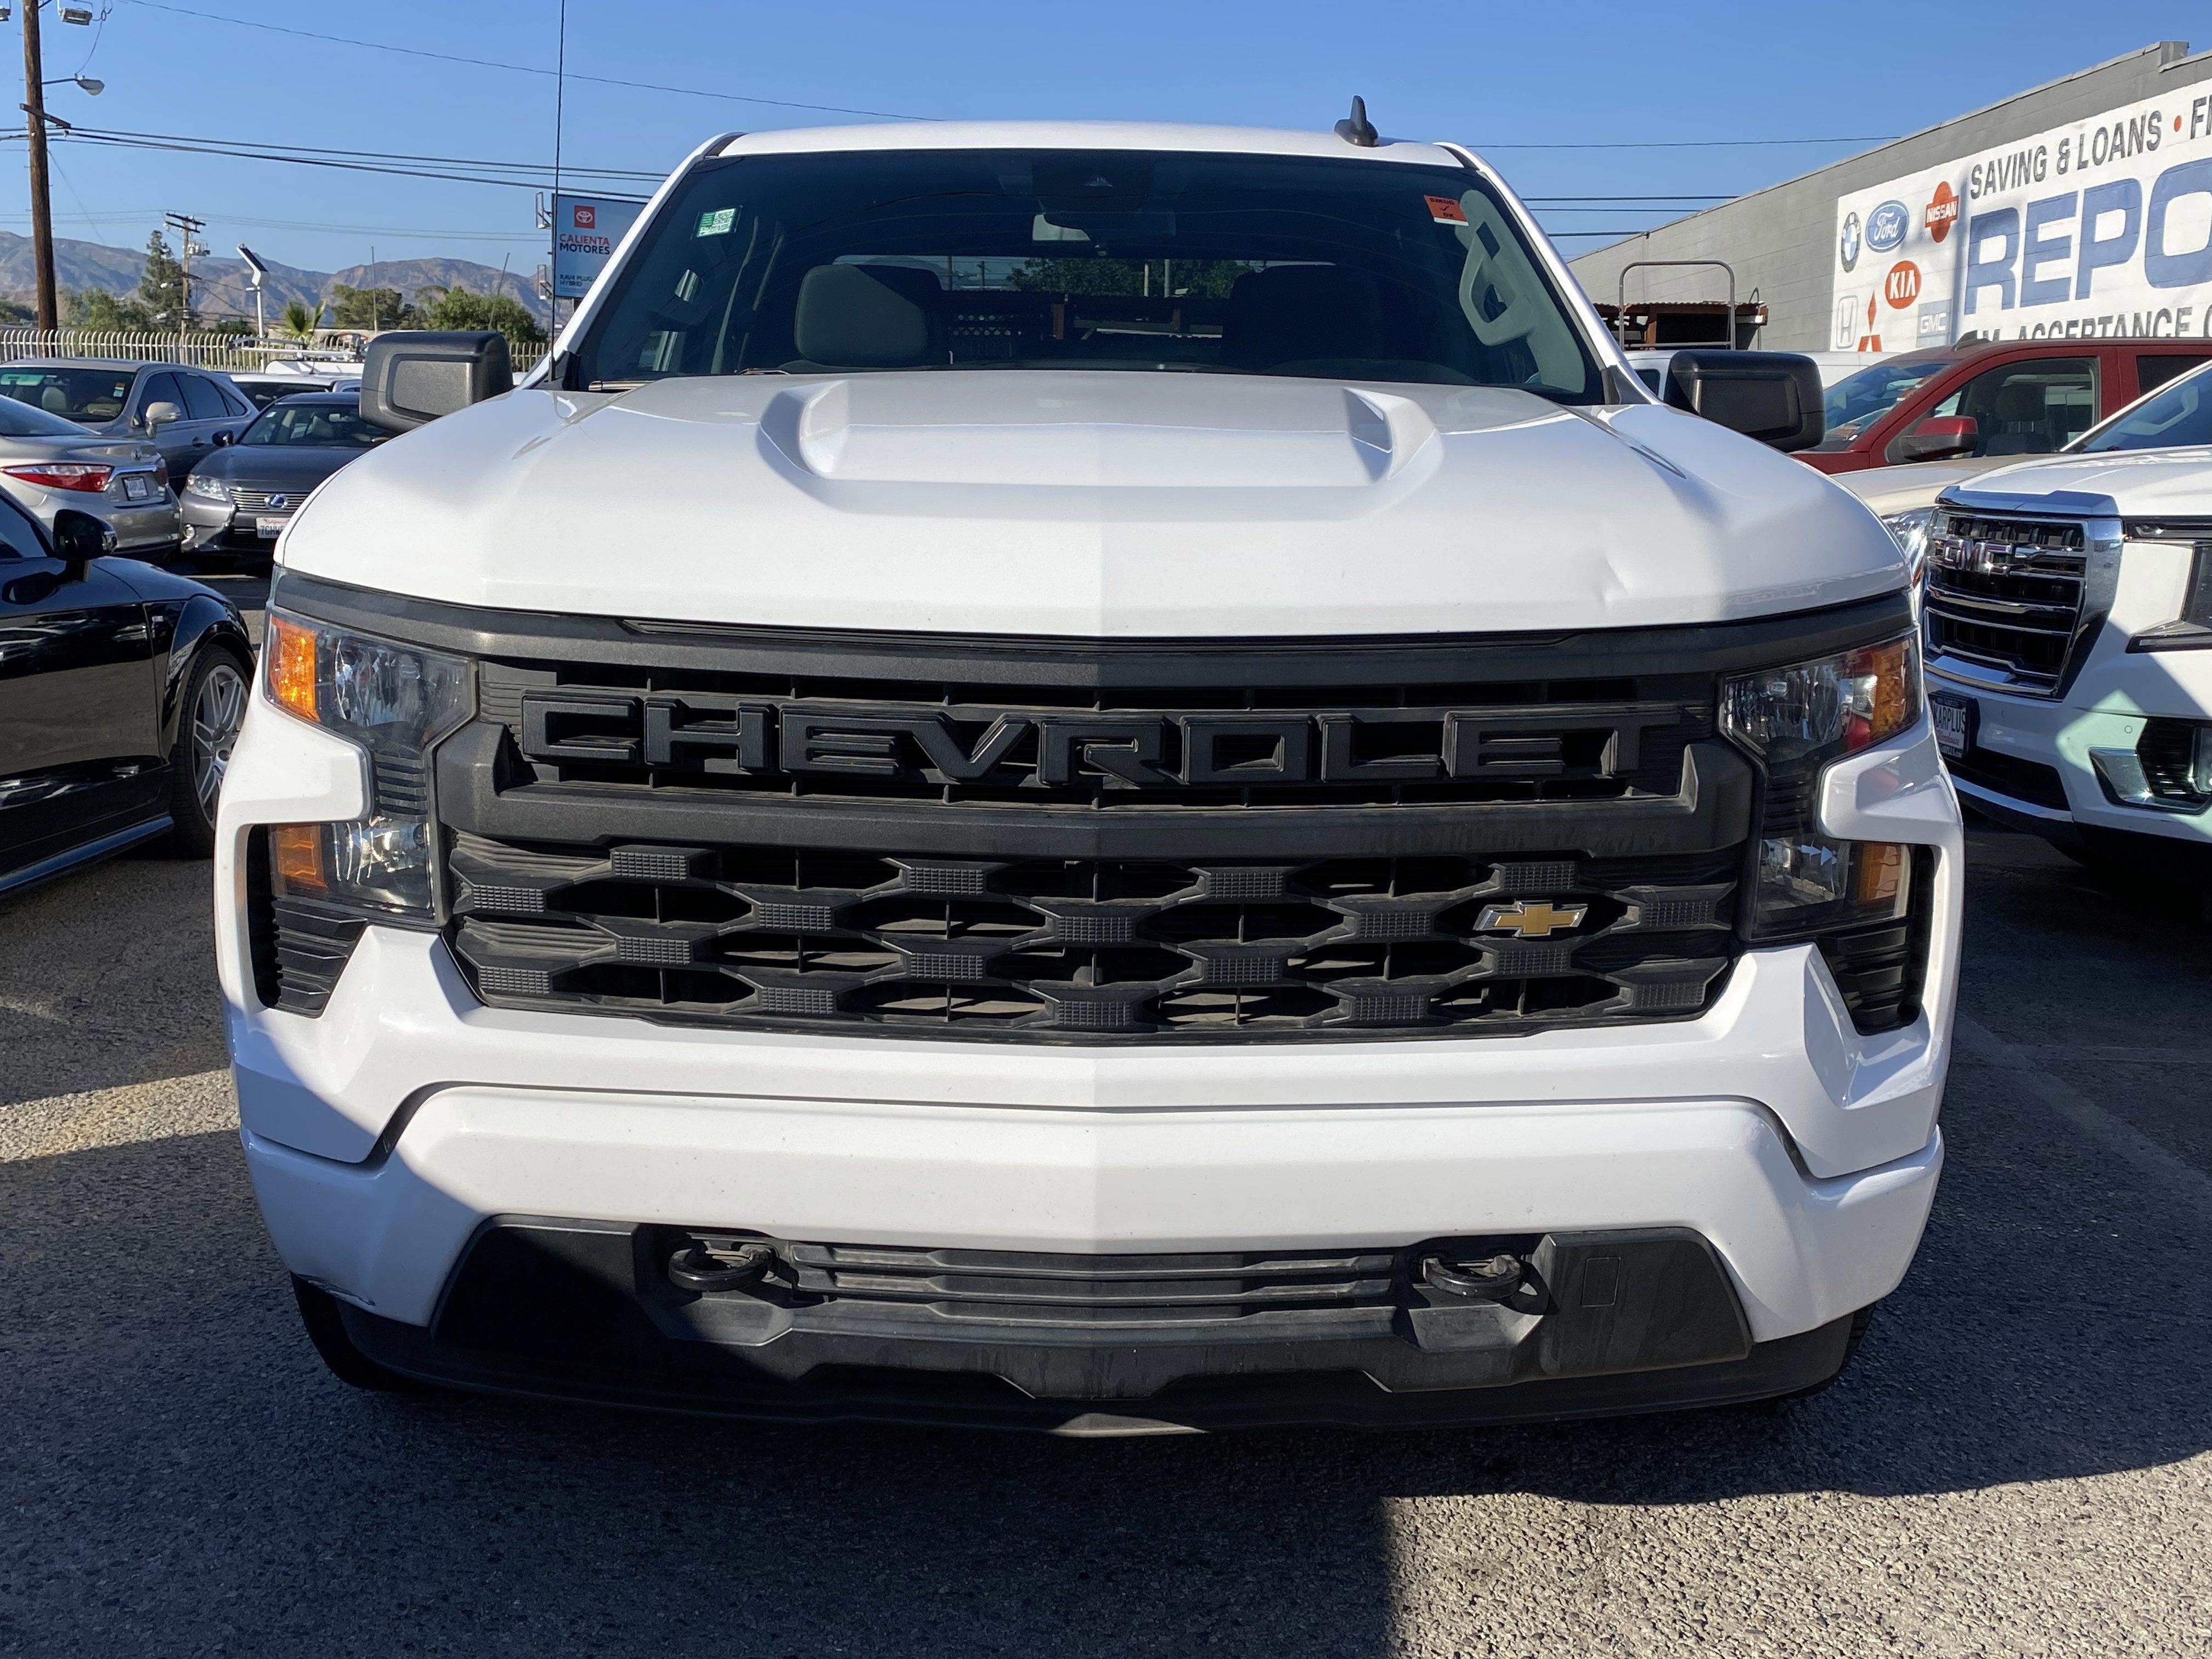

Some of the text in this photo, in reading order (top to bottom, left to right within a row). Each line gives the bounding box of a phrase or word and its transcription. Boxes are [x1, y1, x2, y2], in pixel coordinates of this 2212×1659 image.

[1970, 145, 2047, 200] SAVING
[2057, 138, 2070, 175] &
[2077, 110, 2163, 170] LOANS
[1926, 200, 1957, 223] NISSAN
[559, 233, 610, 246] CALIENTA
[1874, 212, 1901, 241] Ford
[1963, 157, 2212, 315] REPO
[559, 242, 610, 255] MOTORES
[1889, 269, 1916, 300] KIA
[1920, 312, 1947, 334] GMC
[522, 692, 1680, 788] CHEVROLET
